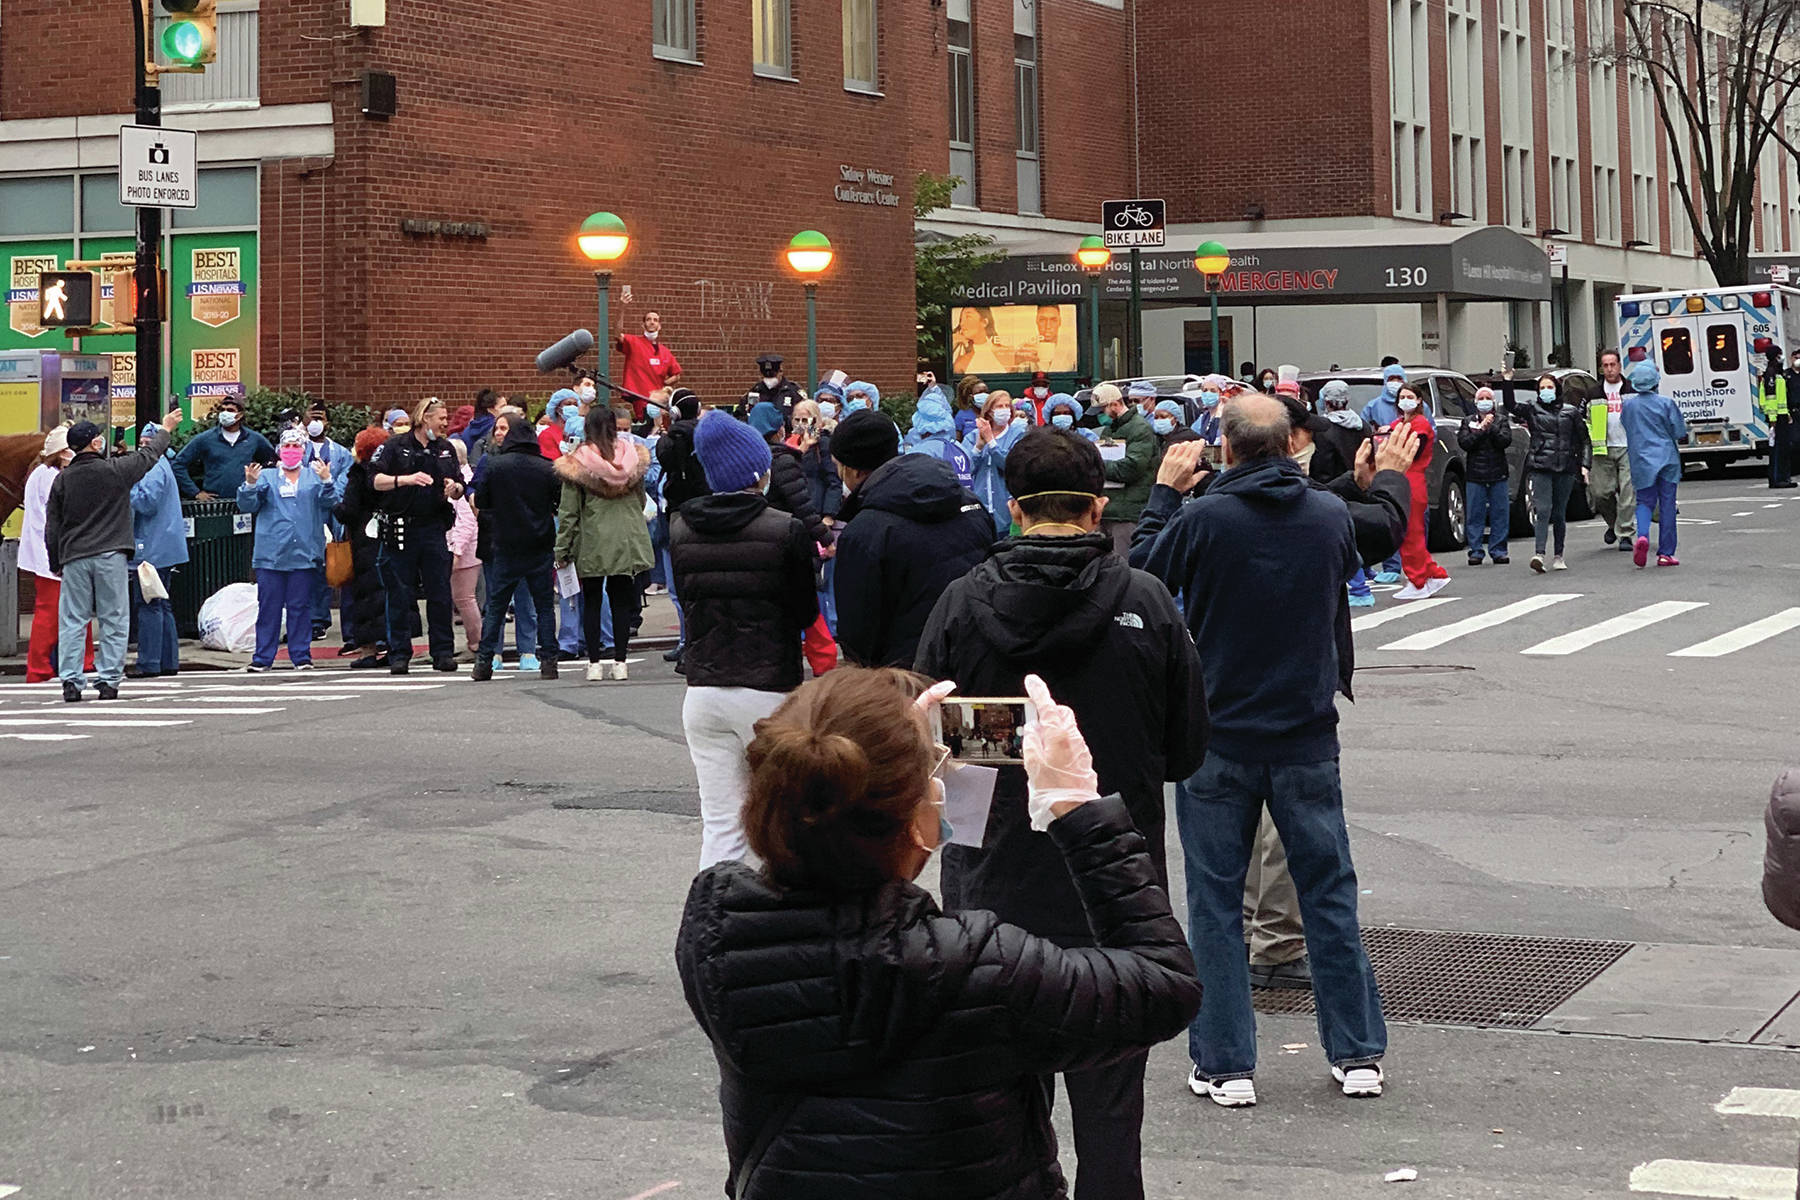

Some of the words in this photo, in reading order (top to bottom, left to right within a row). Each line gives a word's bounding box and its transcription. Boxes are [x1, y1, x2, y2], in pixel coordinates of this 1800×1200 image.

[138, 170, 153, 182] BUS
[156, 171, 180, 183] LANES
[127, 186, 151, 199] PHOTO
[153, 188, 190, 201] ENFORCED
[834, 185, 875, 204] Conference
[876, 189, 899, 207] Center
[1106, 233, 1131, 244] BIKE
[1134, 232, 1162, 244] LANE
[14, 259, 54, 274] BEST
[195, 252, 237, 268] BEST
[1041, 262, 1078, 272] Lenox
[1230, 256, 1260, 267] ealth
[195, 269, 237, 280] HOSPITALS
[1384, 267, 1428, 287] 130
[1018, 280, 1081, 296] Pavilion
[1753, 324, 1770, 333] 605
[74, 360, 97, 371] TITAN
[194, 353, 237, 369] BEST
[195, 370, 237, 381] HOSPITALS
[1672, 389, 1703, 398] North
[1705, 388, 1736, 397] Shore
[1682, 409, 1716, 419] ospital
